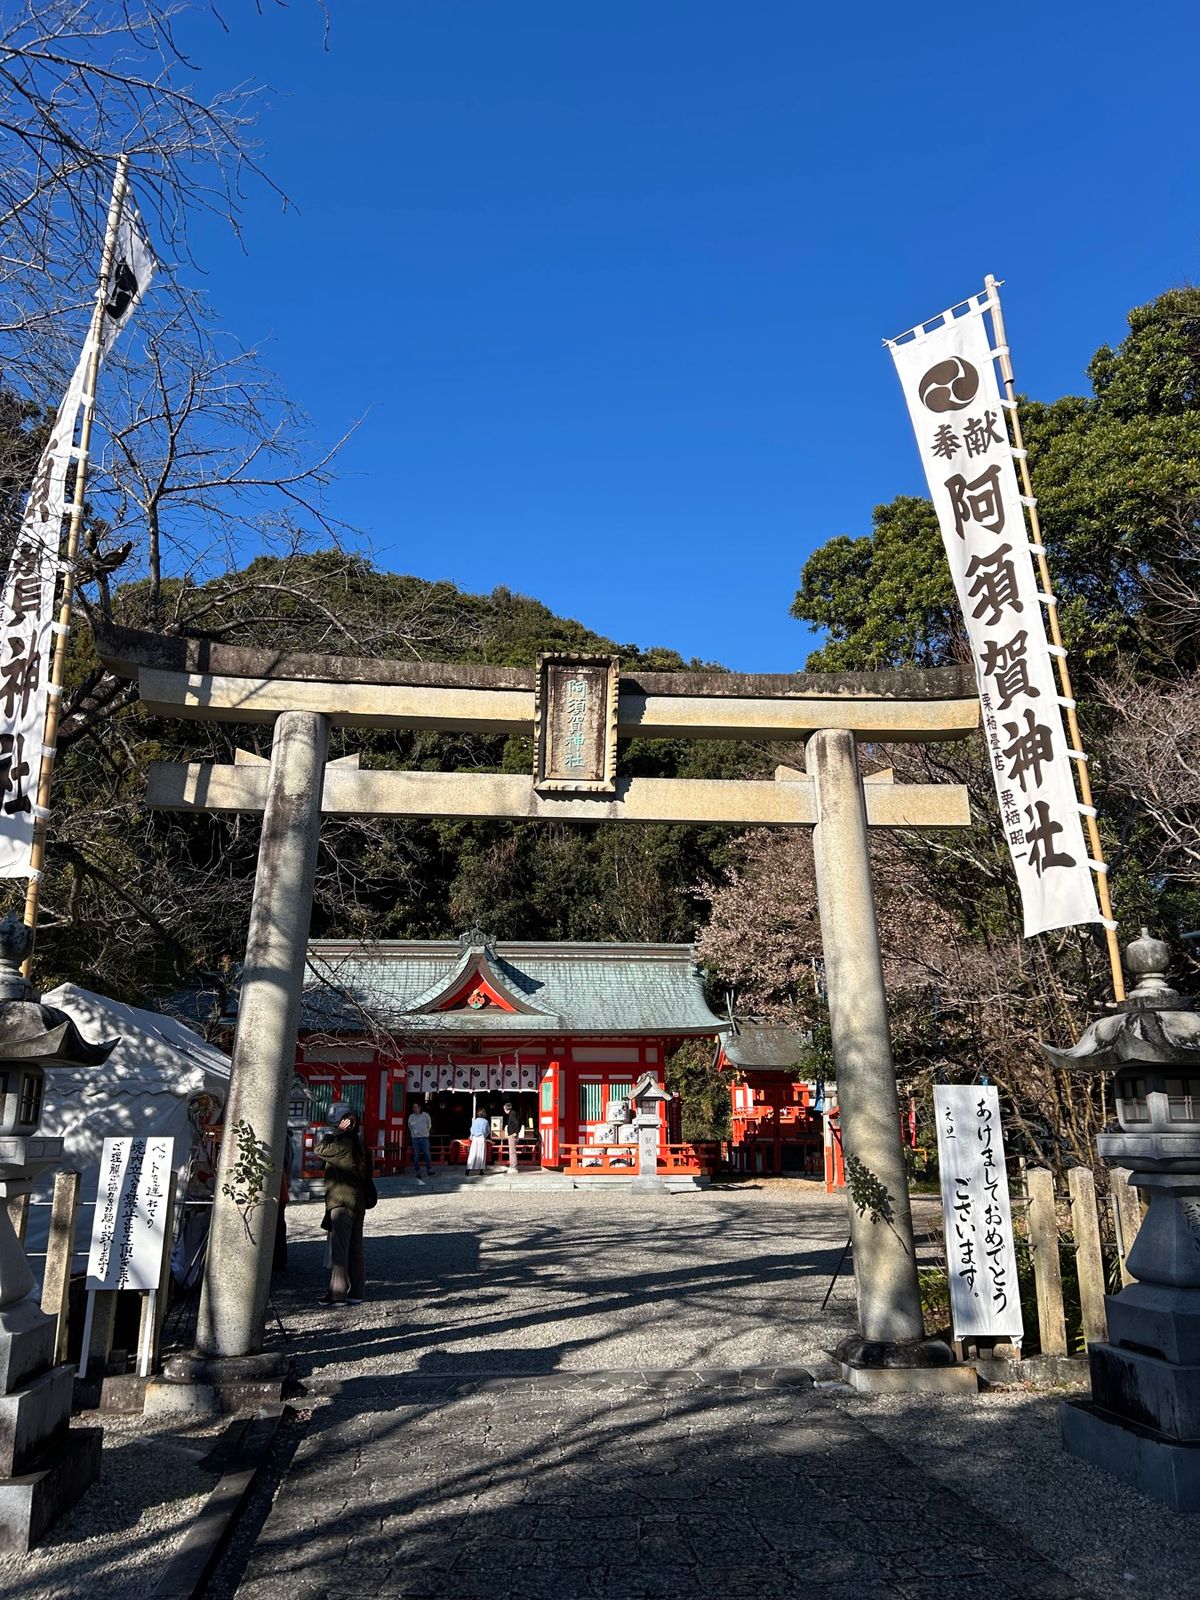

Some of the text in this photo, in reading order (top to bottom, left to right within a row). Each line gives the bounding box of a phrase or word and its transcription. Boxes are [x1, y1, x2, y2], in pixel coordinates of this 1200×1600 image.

[930, 410, 1005, 460] 奉献
[944, 464, 1077, 879] 阿須賀神社
[565, 679, 588, 768] 阿須賀神社
[1000, 789, 1028, 861] 栗栖昭一
[944, 1106, 957, 1139] 元旦
[976, 1098, 1008, 1314] あけましておめでとう
